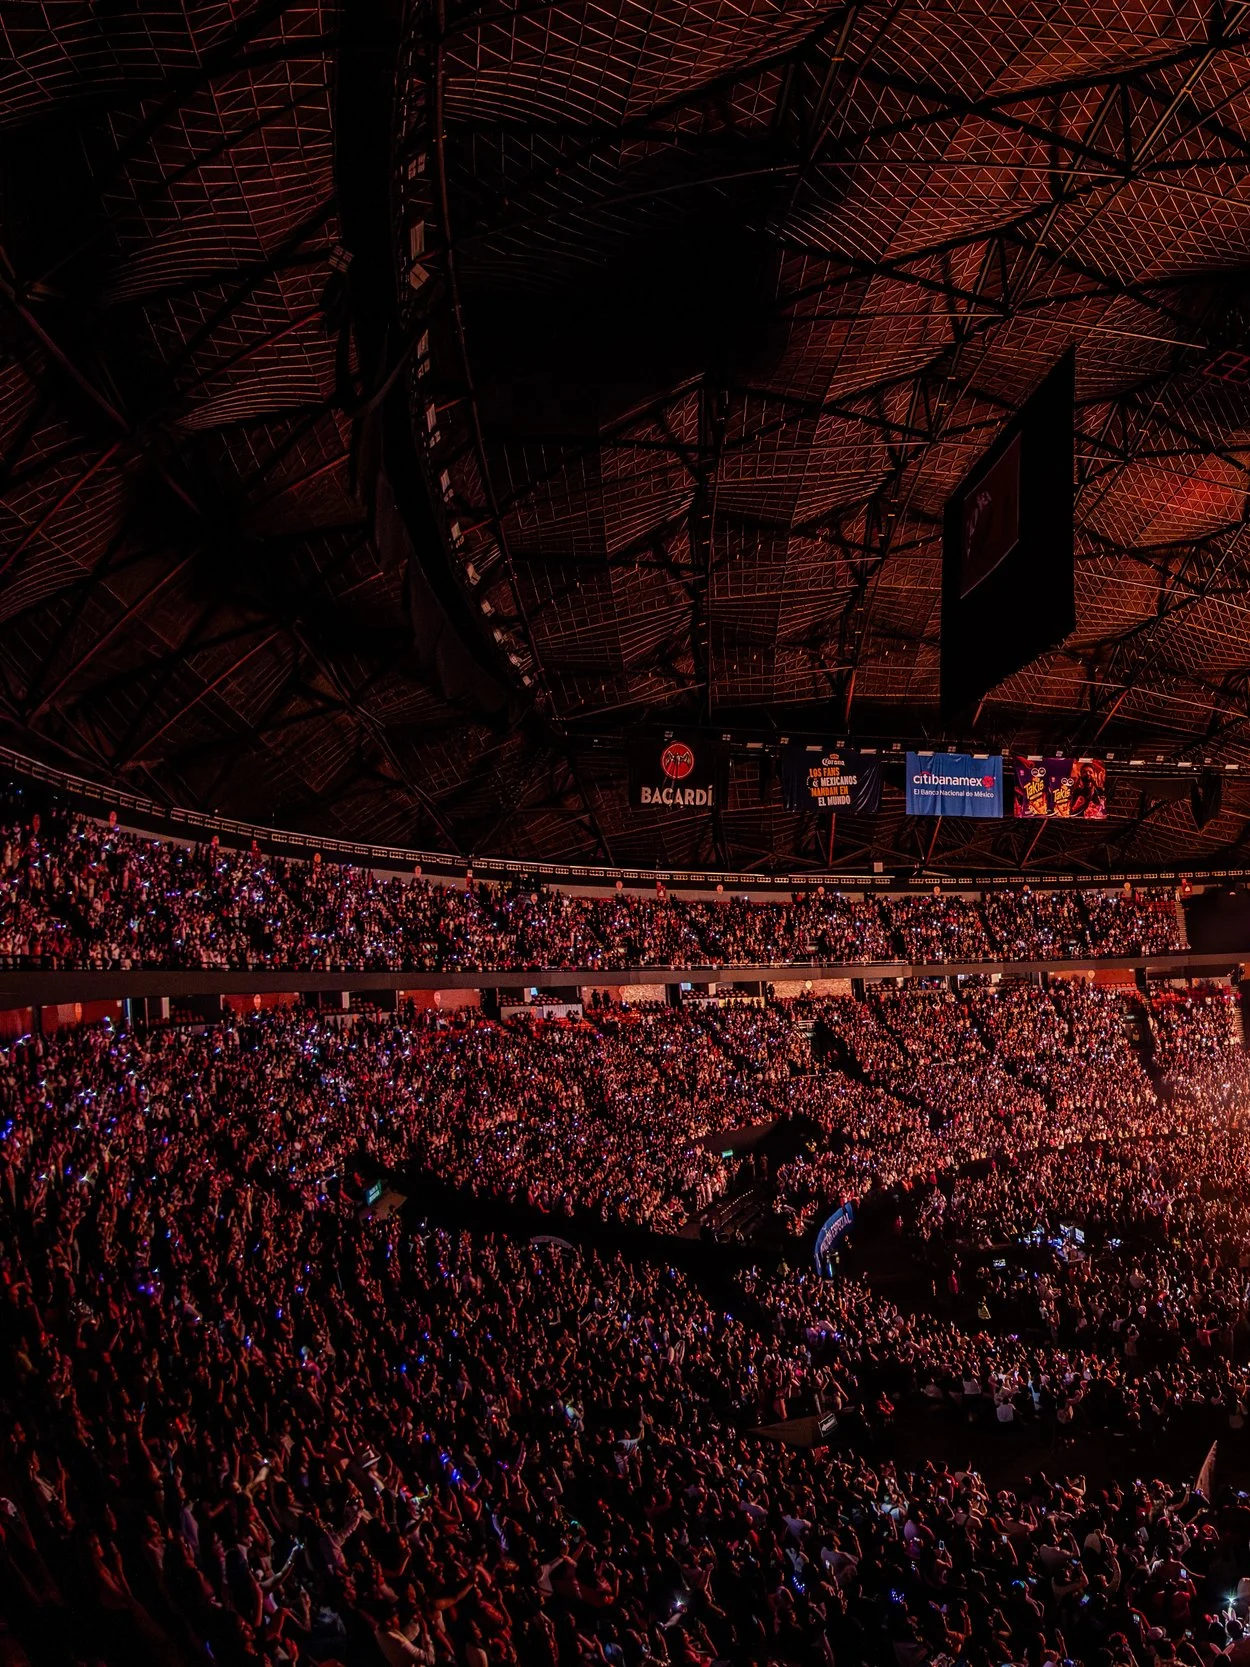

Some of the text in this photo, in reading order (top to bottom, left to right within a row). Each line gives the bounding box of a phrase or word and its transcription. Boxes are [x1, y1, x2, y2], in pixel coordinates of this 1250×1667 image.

[822, 758, 845, 766] Corona
[809, 767, 840, 777] LOS FANS
[821, 775, 857, 786] MEXICANOS
[912, 773, 983, 787] citibanamex
[811, 786, 848, 797] MANDAN EN
[939, 789, 965, 797] Nacional
[974, 790, 994, 798] México
[1023, 780, 1044, 799] Takis
[1052, 788, 1071, 802] Takis
[640, 784, 714, 807] BACARDÍ
[818, 795, 850, 806] EL MUNDO
